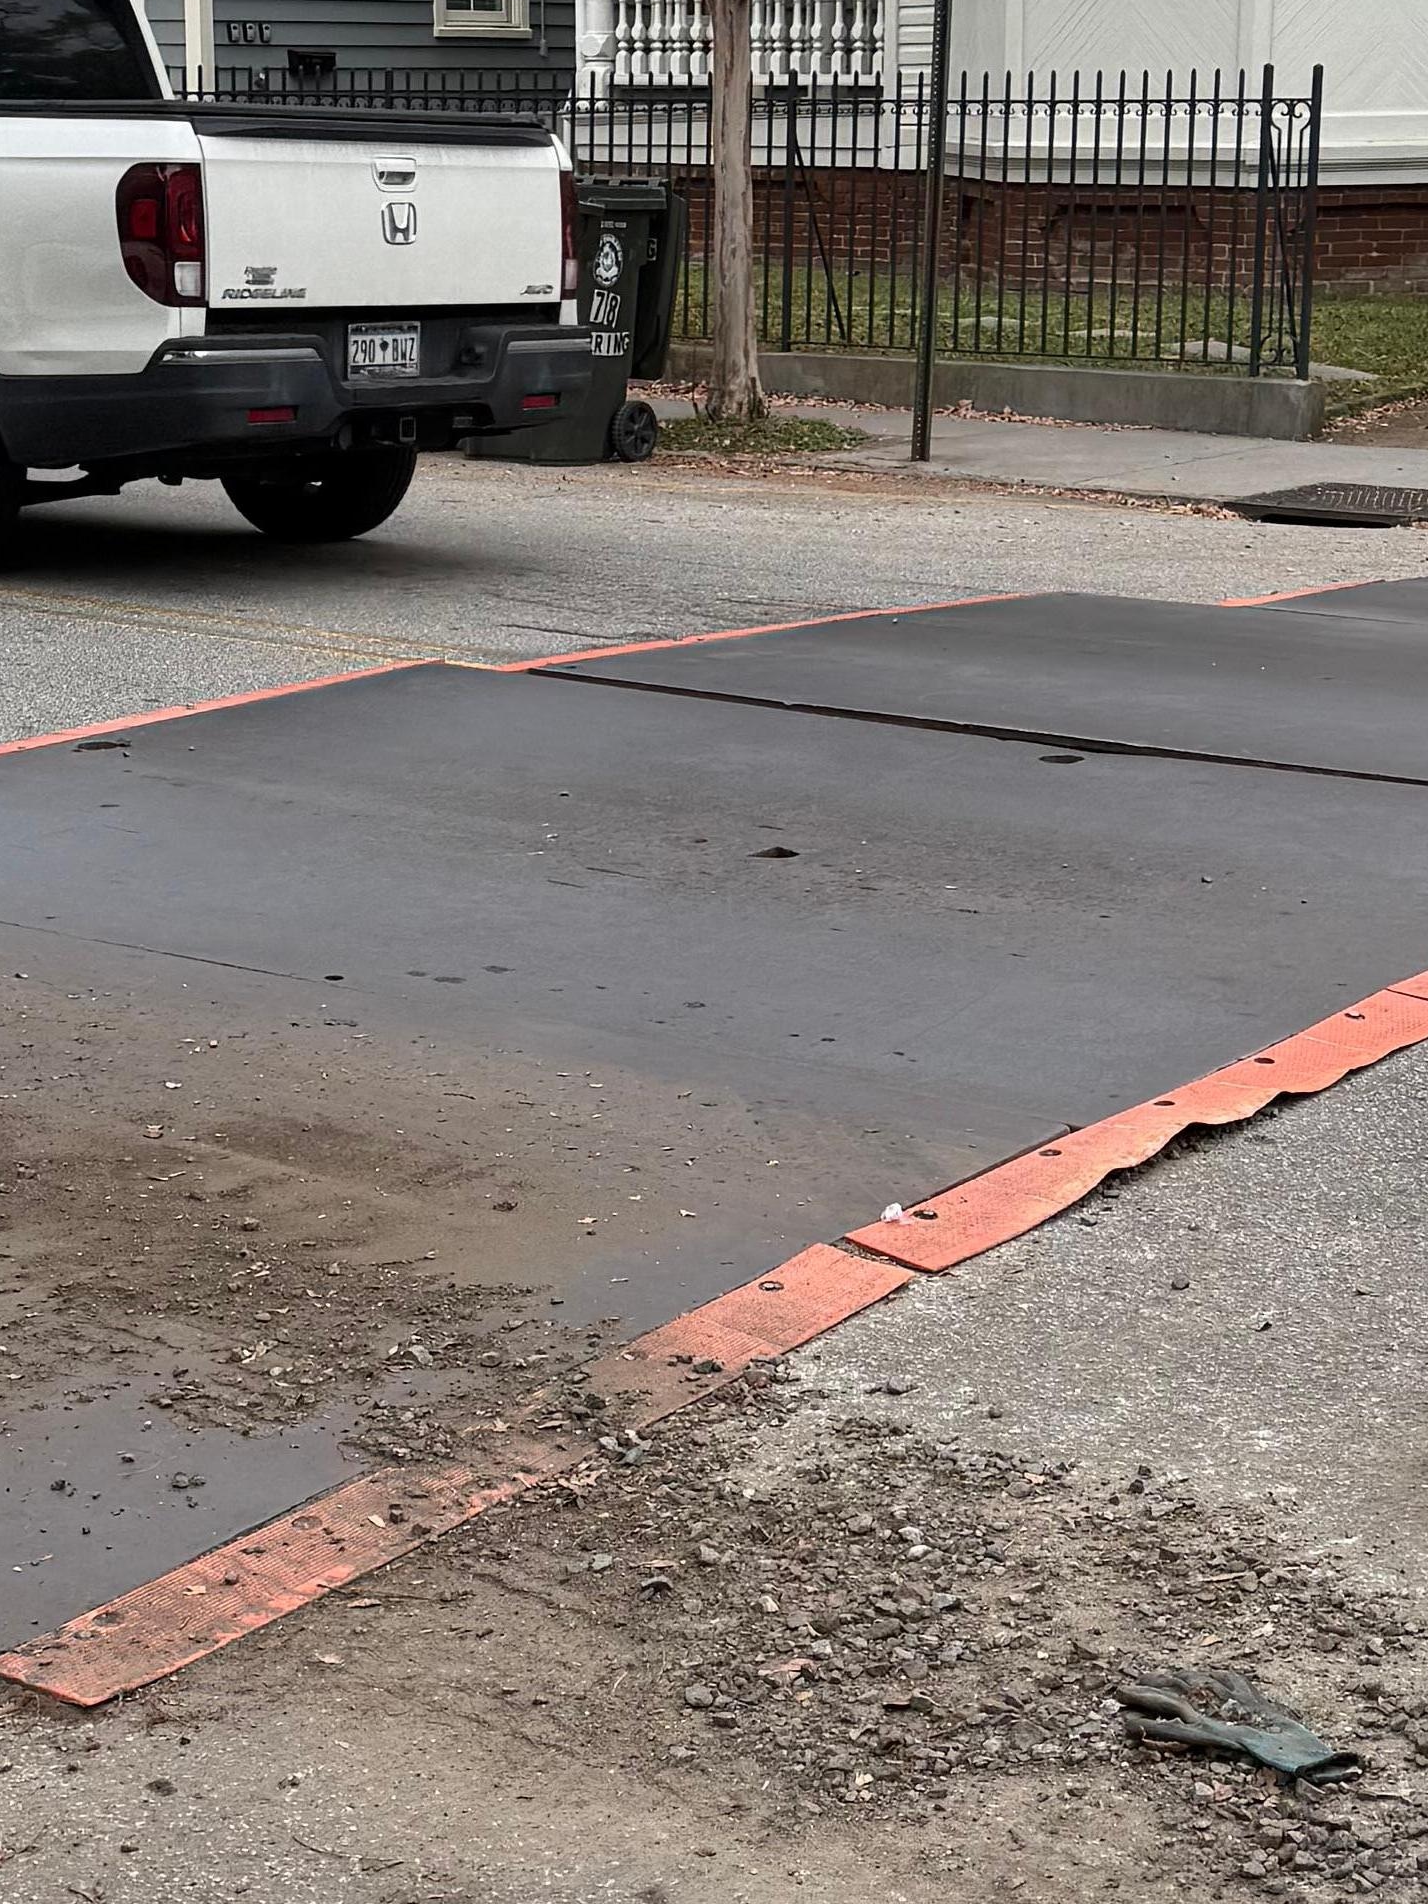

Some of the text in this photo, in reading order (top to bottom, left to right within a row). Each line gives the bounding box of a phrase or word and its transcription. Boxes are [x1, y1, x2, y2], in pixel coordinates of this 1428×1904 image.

[221, 288, 307, 299] RIDGELINE
[592, 290, 620, 327] 78
[352, 339, 376, 363] 290
